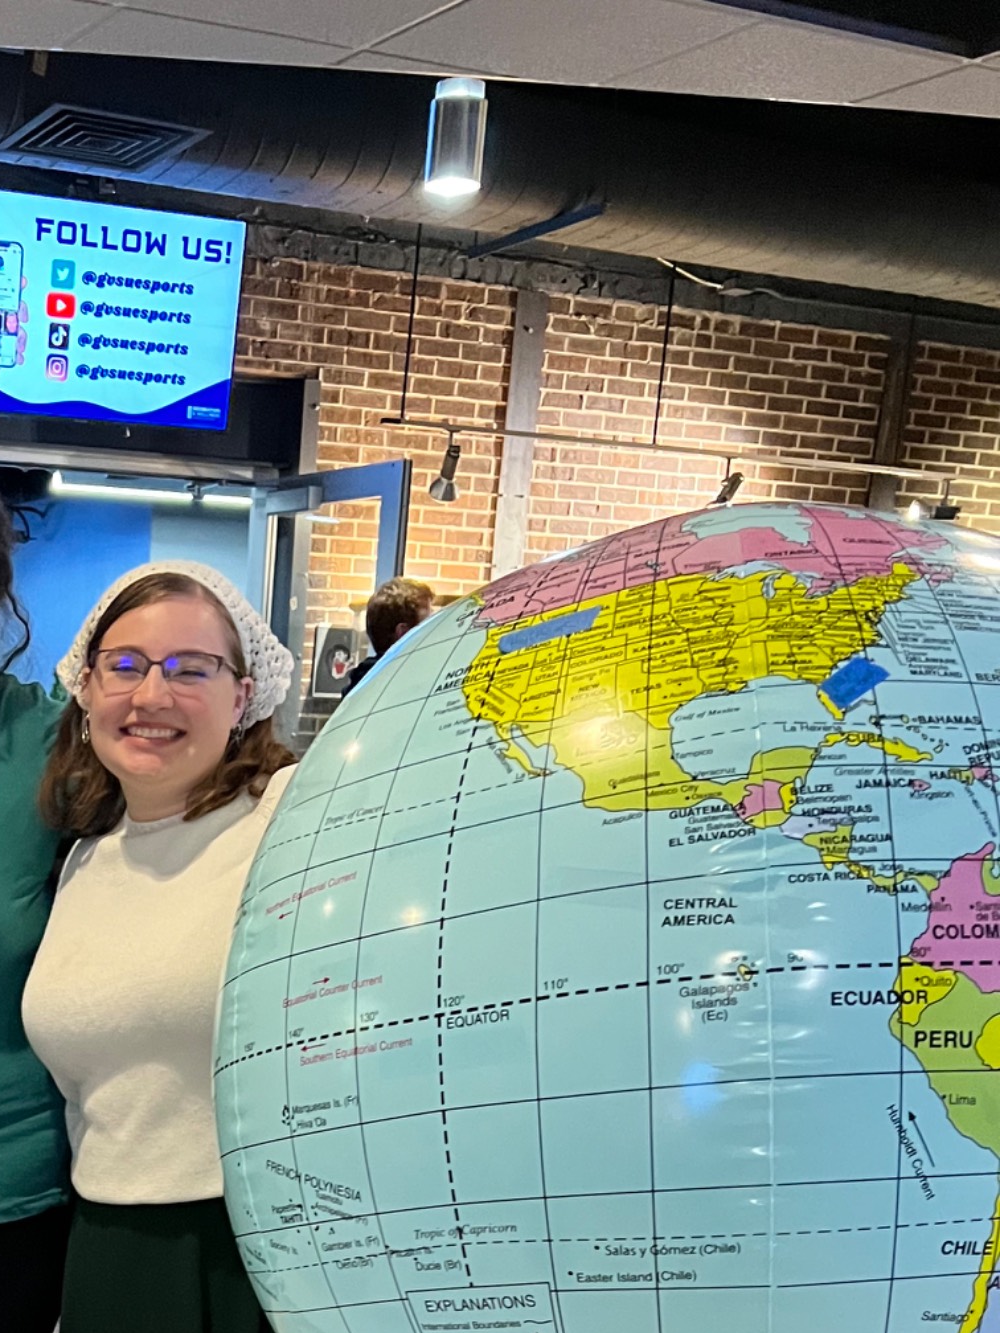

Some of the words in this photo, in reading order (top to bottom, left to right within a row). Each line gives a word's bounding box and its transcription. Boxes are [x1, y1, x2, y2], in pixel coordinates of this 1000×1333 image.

[36, 217, 166, 256] FOLLOW
[181, 236, 232, 264] US!
[82, 270, 194, 295] @gvsuesports
[80, 301, 192, 325] @gvsuesports
[78, 333, 189, 356] @gvsuesports
[76, 364, 186, 387] @gvsuesports
[446, 661, 491, 680] NORTH
[435, 671, 493, 693] AMERICA
[630, 682, 662, 696] TEXAS
[917, 715, 982, 725] BAHAMAS
[847, 733, 884, 743] CUBA
[790, 783, 834, 795] BELIZE
[855, 778, 917, 789] JAMAICA
[669, 802, 747, 820] GUATEMALA
[802, 804, 873, 816] HONDURAS
[669, 837, 684, 848] EL
[687, 827, 756, 845] SALVADOR
[819, 833, 893, 844] NICARAGUA
[788, 872, 831, 884] COSTA
[867, 884, 918, 894] PANAMA
[663, 898, 738, 910] CENTRAL
[661, 913, 736, 928] AMERICA
[920, 976, 952, 987] Quito
[831, 991, 928, 1006] ECUADOR
[446, 1009, 510, 1030] EQUATOR
[701, 1010, 728, 1024] (Ec)
[379, 1038, 413, 1051] Current
[914, 1030, 973, 1048] PERU
[949, 1094, 976, 1106] Lima
[886, 1103, 917, 1159] Humboldt
[911, 1158, 936, 1201] Current
[266, 1159, 302, 1184] FRENCH
[303, 1172, 362, 1203] POLYNESIA
[413, 1227, 447, 1241] Tropic
[462, 1222, 517, 1236] Capricorn
[605, 1244, 637, 1257] Salas
[651, 1243, 696, 1256] Gómez
[700, 1242, 741, 1257] (Chile)
[941, 1240, 994, 1256] CHILE
[576, 1272, 614, 1284] Easter
[617, 1272, 653, 1283] Island
[656, 1269, 697, 1282] (Chile)
[424, 1294, 536, 1313] EXPLANATIONS
[921, 1311, 970, 1324] Santiago
